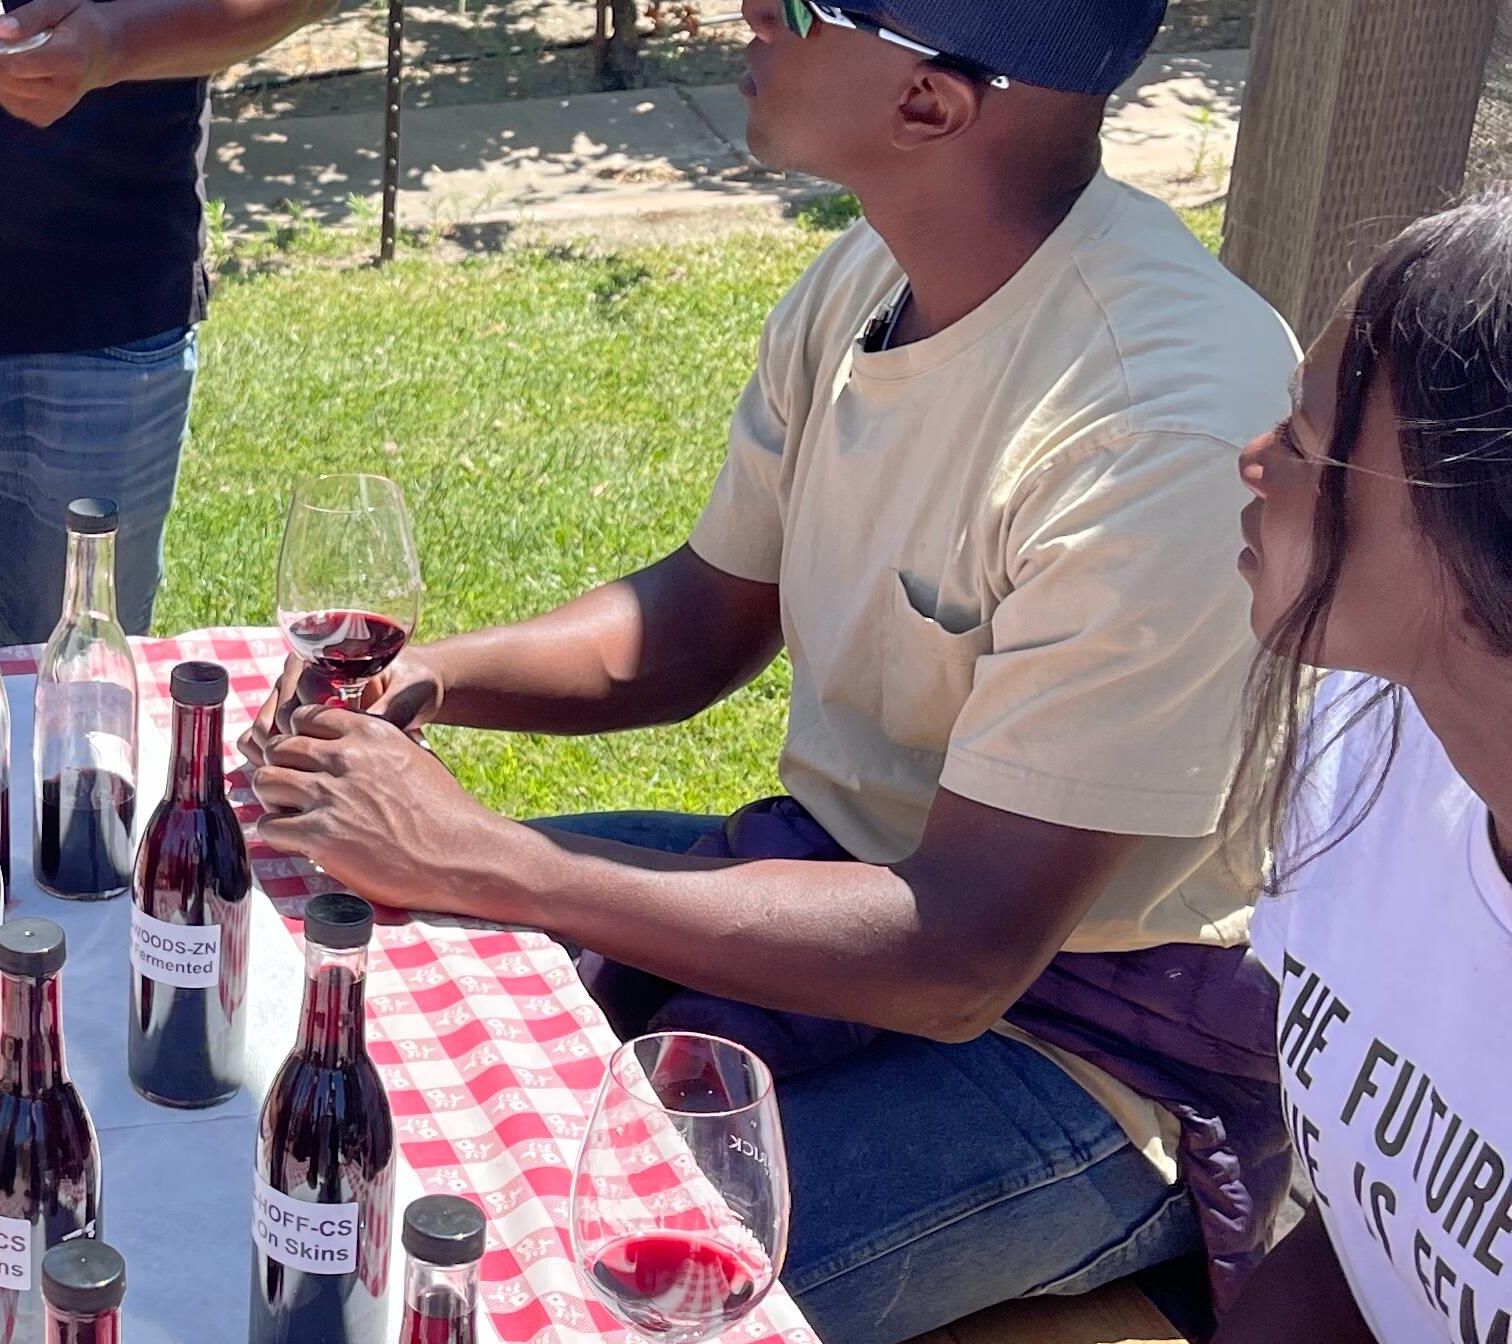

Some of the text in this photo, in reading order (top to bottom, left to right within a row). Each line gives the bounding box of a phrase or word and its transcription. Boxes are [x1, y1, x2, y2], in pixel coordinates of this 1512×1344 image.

[135, 942, 213, 974] Fermented
[1279, 949, 1351, 1089] THE
[257, 1219, 350, 1262] On Skins
